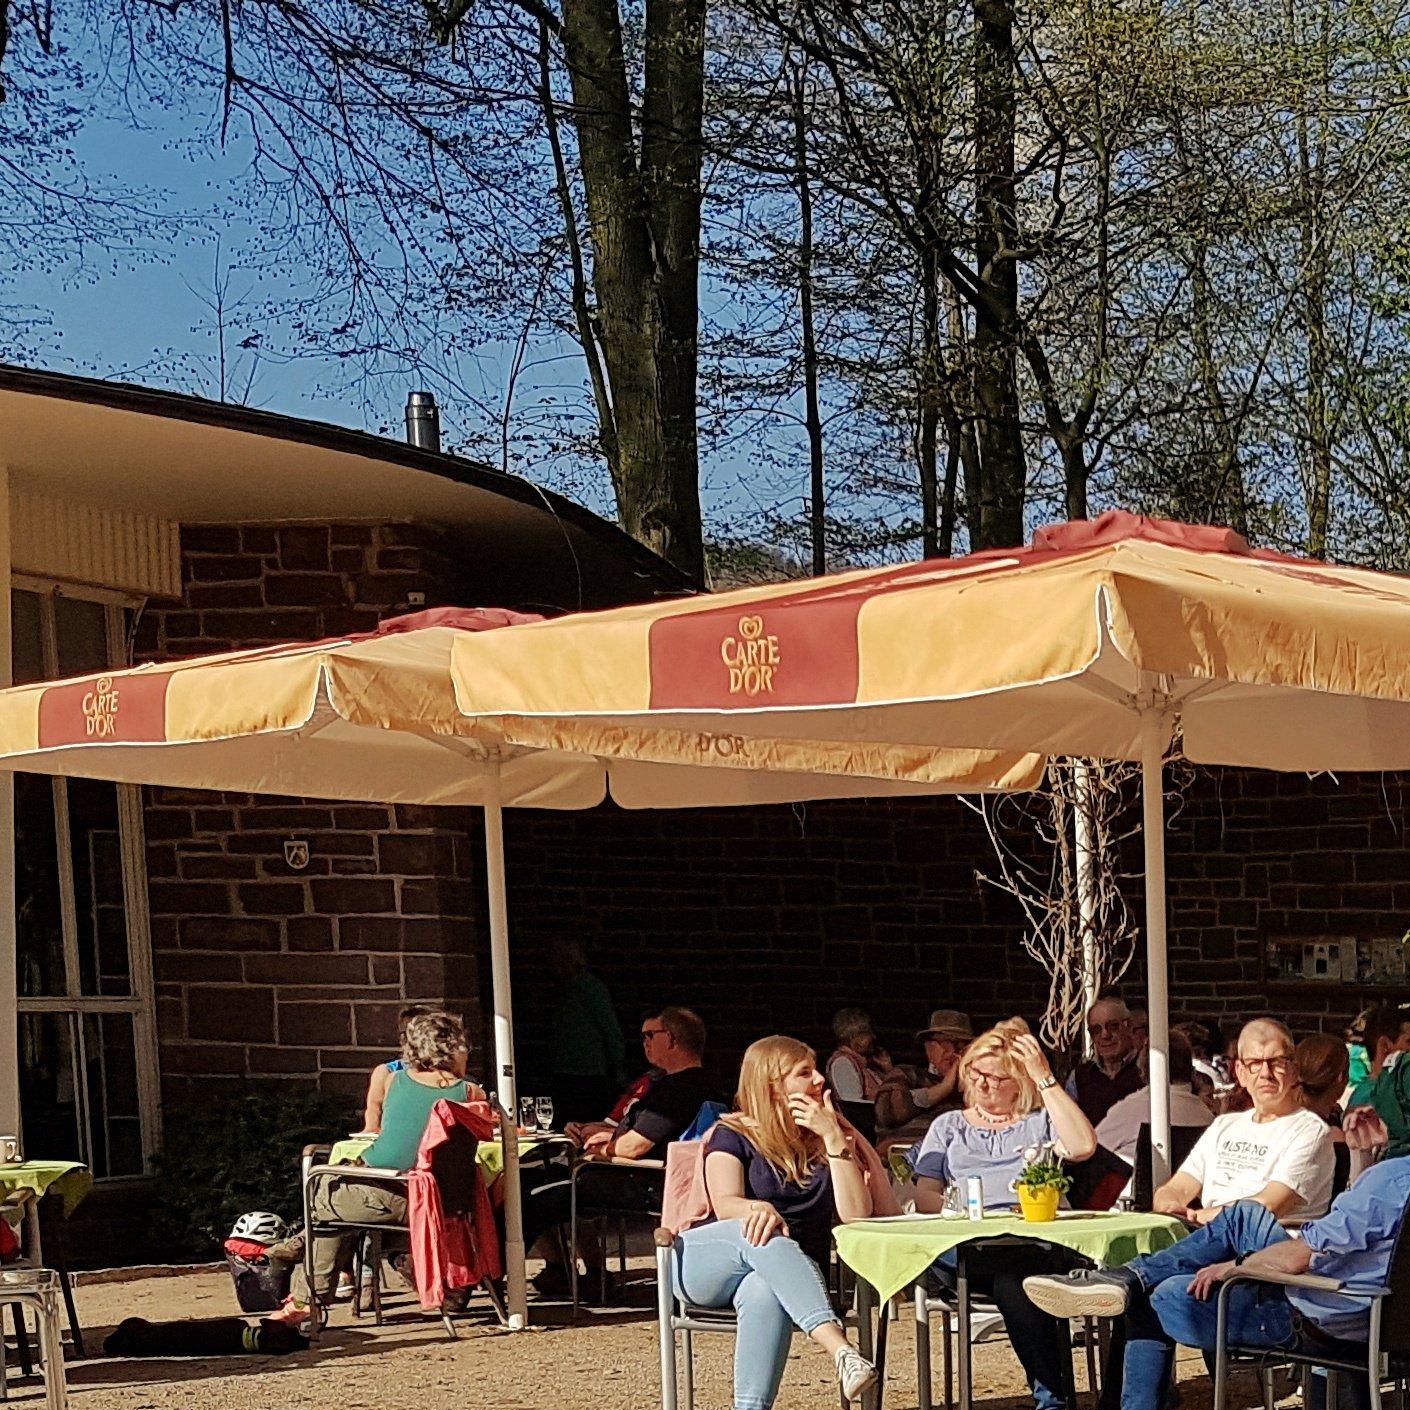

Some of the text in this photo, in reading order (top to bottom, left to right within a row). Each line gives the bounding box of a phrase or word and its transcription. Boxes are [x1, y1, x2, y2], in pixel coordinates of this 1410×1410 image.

[721, 636, 780, 666] CARTE
[729, 667, 774, 696] D'OR
[82, 691, 119, 718] CARTE
[86, 713, 115, 738] D'OR
